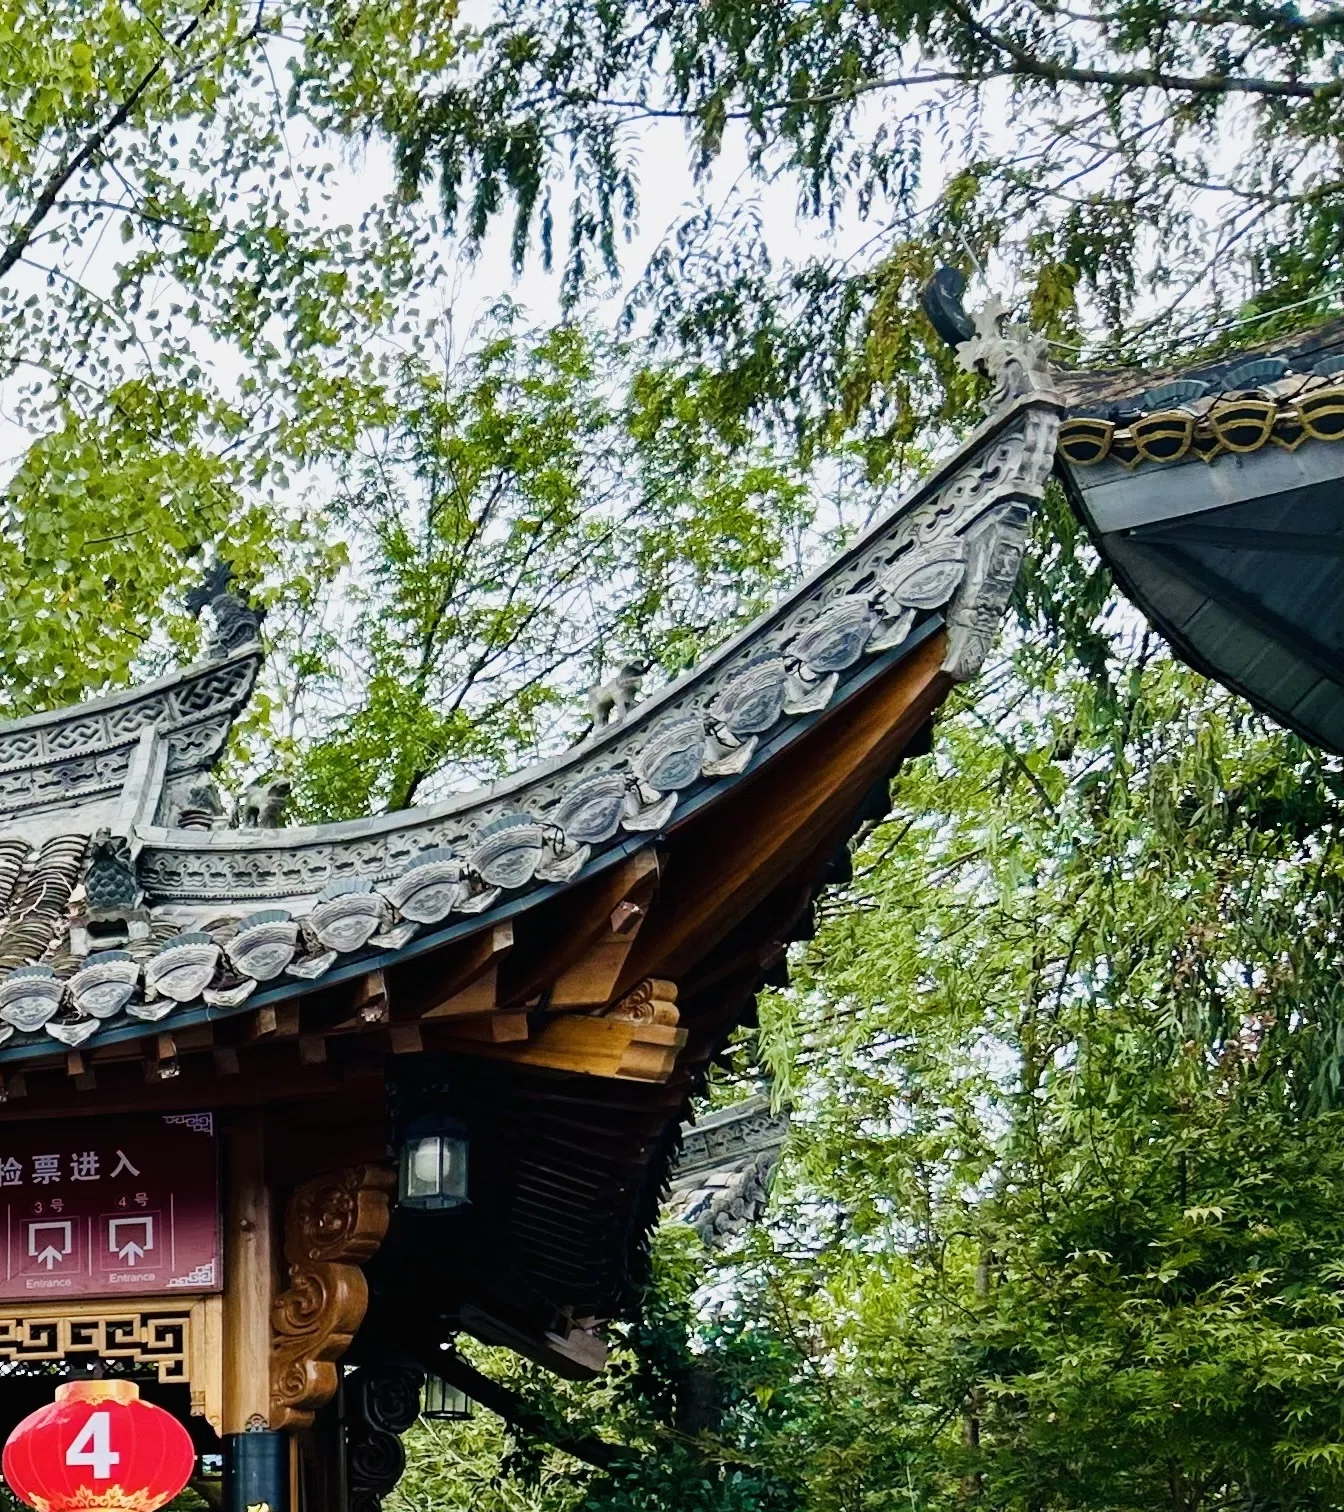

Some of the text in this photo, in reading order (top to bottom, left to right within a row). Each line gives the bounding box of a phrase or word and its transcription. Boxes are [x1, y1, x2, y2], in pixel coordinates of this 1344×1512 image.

[110, 1272, 155, 1283] Entrance
[26, 1278, 72, 1289] Entrance
[65, 1411, 119, 1478] 4
